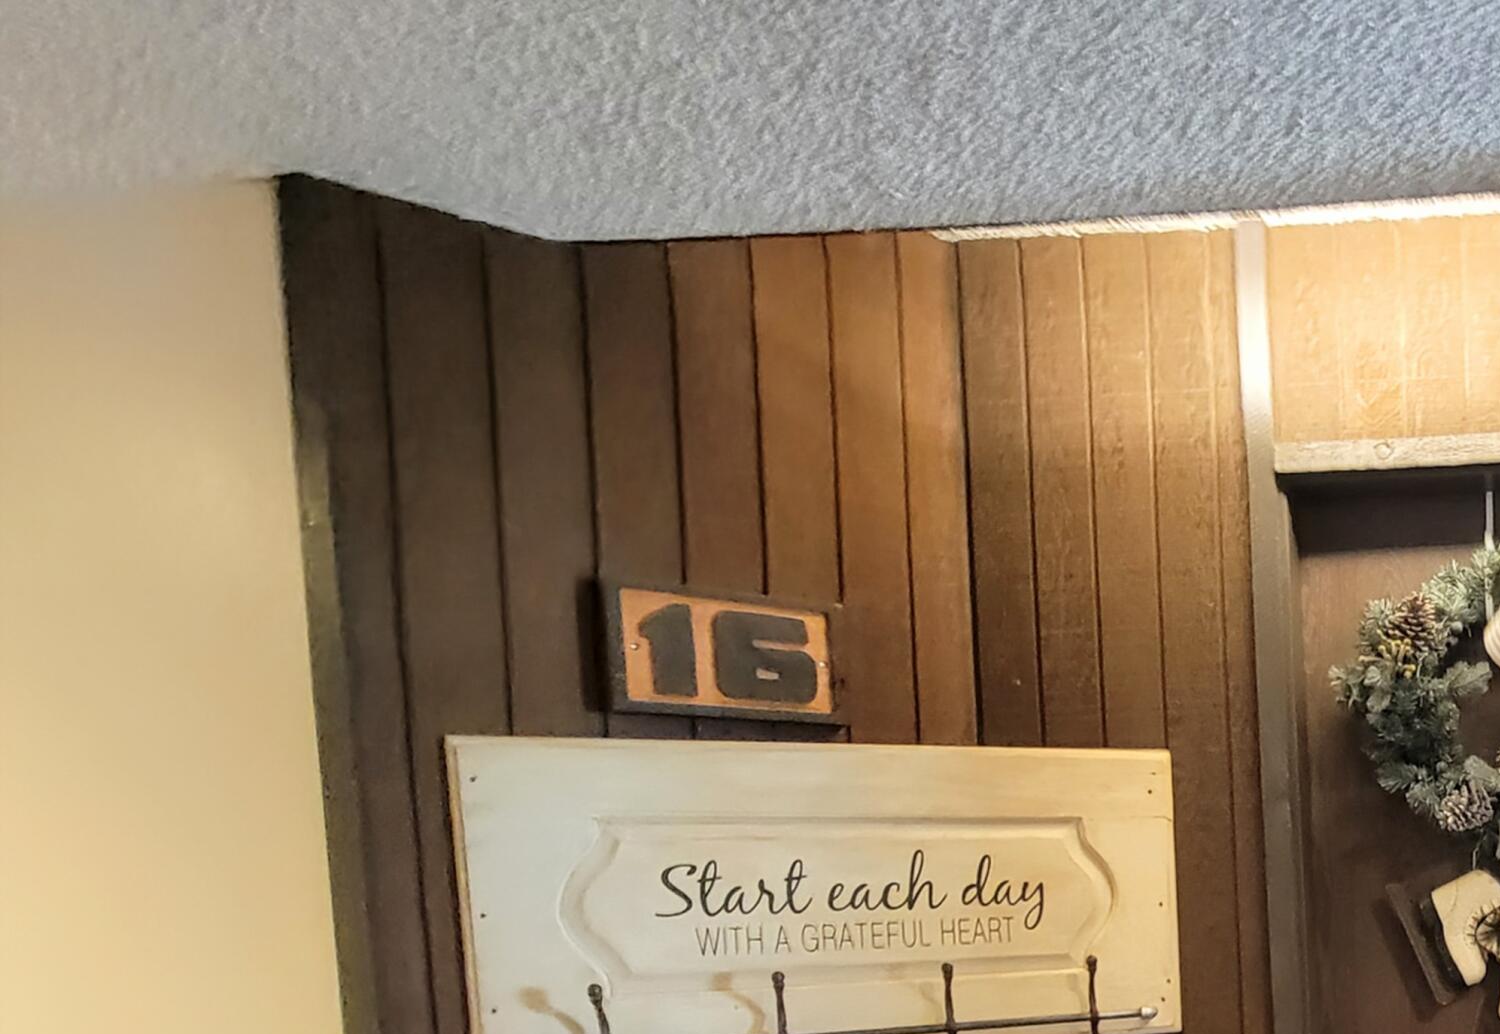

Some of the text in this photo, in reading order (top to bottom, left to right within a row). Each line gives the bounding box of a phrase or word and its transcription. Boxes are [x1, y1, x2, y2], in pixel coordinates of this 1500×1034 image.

[638, 603, 818, 704] 16
[655, 849, 1045, 930] Start each day
[695, 916, 1014, 956] WITH A GRATEFUL HEART
